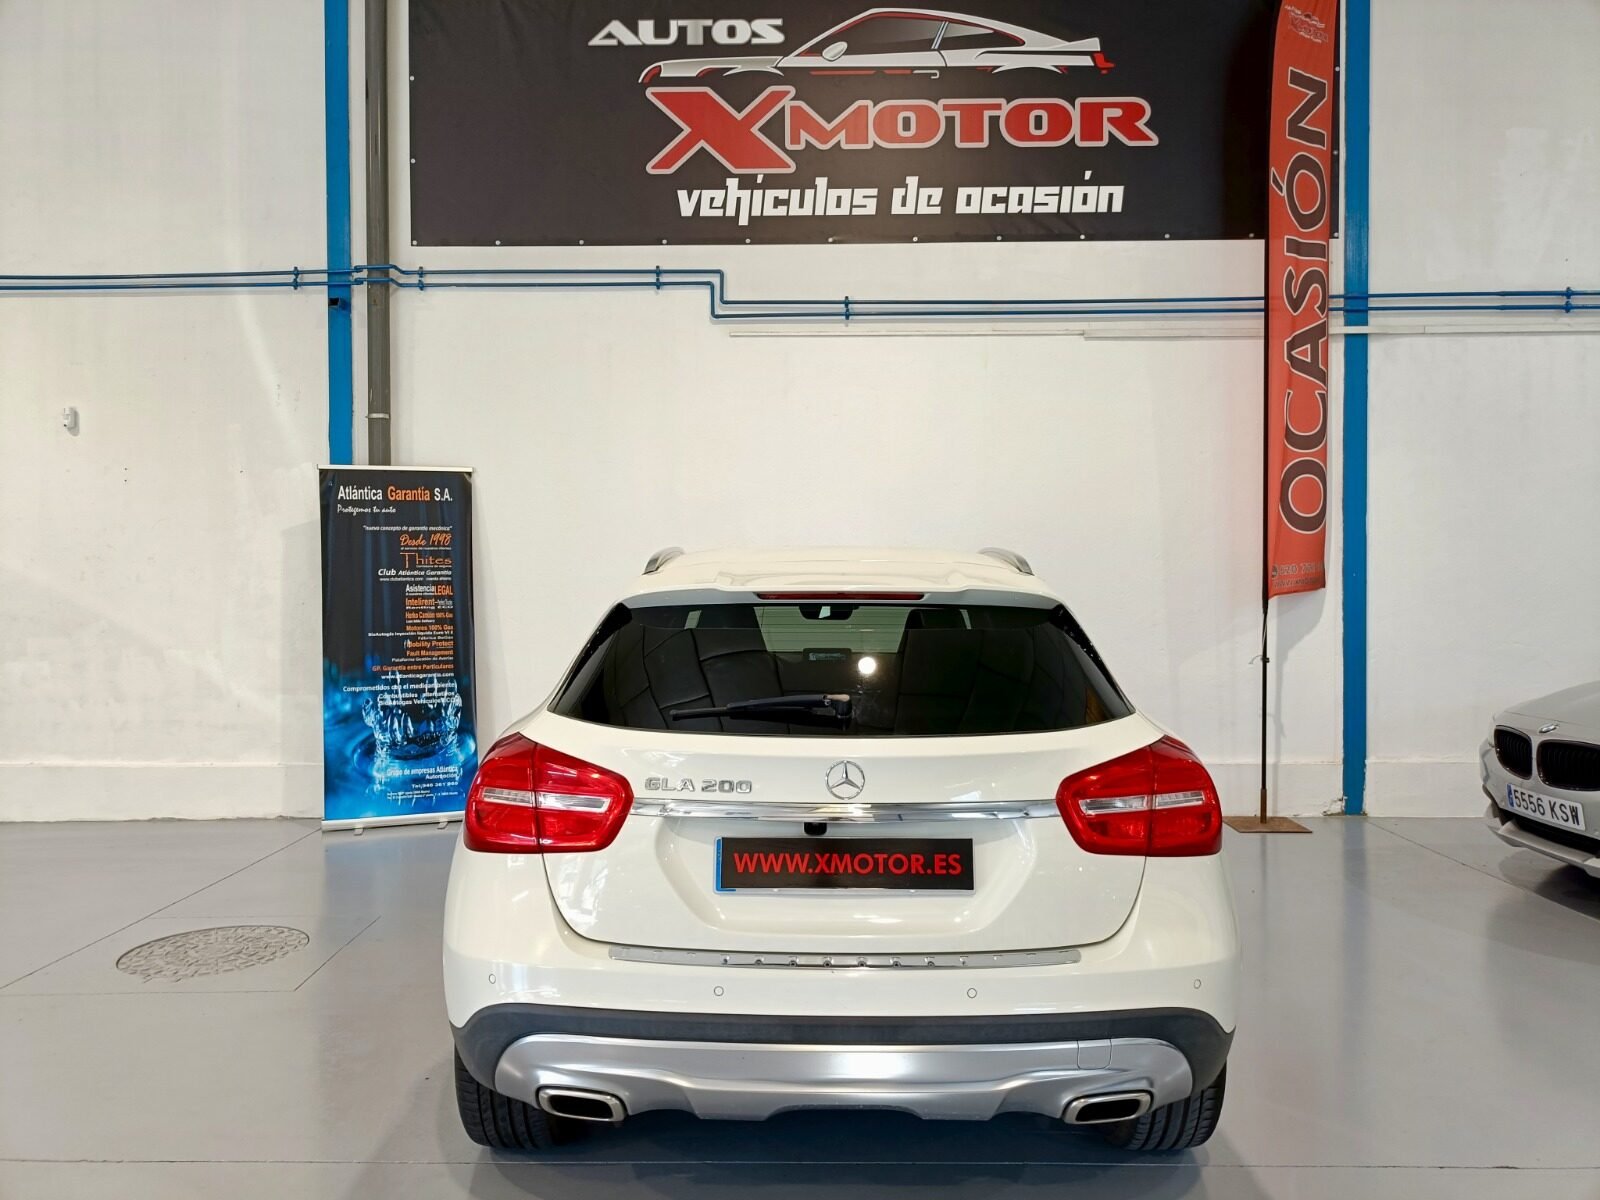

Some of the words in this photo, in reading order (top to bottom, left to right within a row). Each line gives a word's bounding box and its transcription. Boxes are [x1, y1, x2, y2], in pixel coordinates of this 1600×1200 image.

[587, 18, 786, 47] AUTOS
[645, 85, 1159, 175] XMOTOR
[676, 174, 878, 226] vehículos
[890, 176, 944, 215] de
[955, 170, 1125, 215] ocasión
[1271, 66, 1327, 534] OCASIÓN
[337, 485, 383, 501] Atlántica
[387, 486, 431, 501] Garantía
[434, 487, 453, 501] S.A.
[337, 504, 371, 516] Protegemos
[400, 533, 427, 546] Desde
[429, 532, 452, 546] 1998
[378, 568, 396, 576] Club
[343, 685, 390, 693] Comprometidos
[403, 767, 410, 775] de
[645, 777, 695, 793] GLA
[701, 778, 752, 794] 200
[1513, 788, 1546, 817] 5556
[1548, 799, 1581, 826] KSW
[733, 852, 962, 876] WWW.XMOTOR.ES
